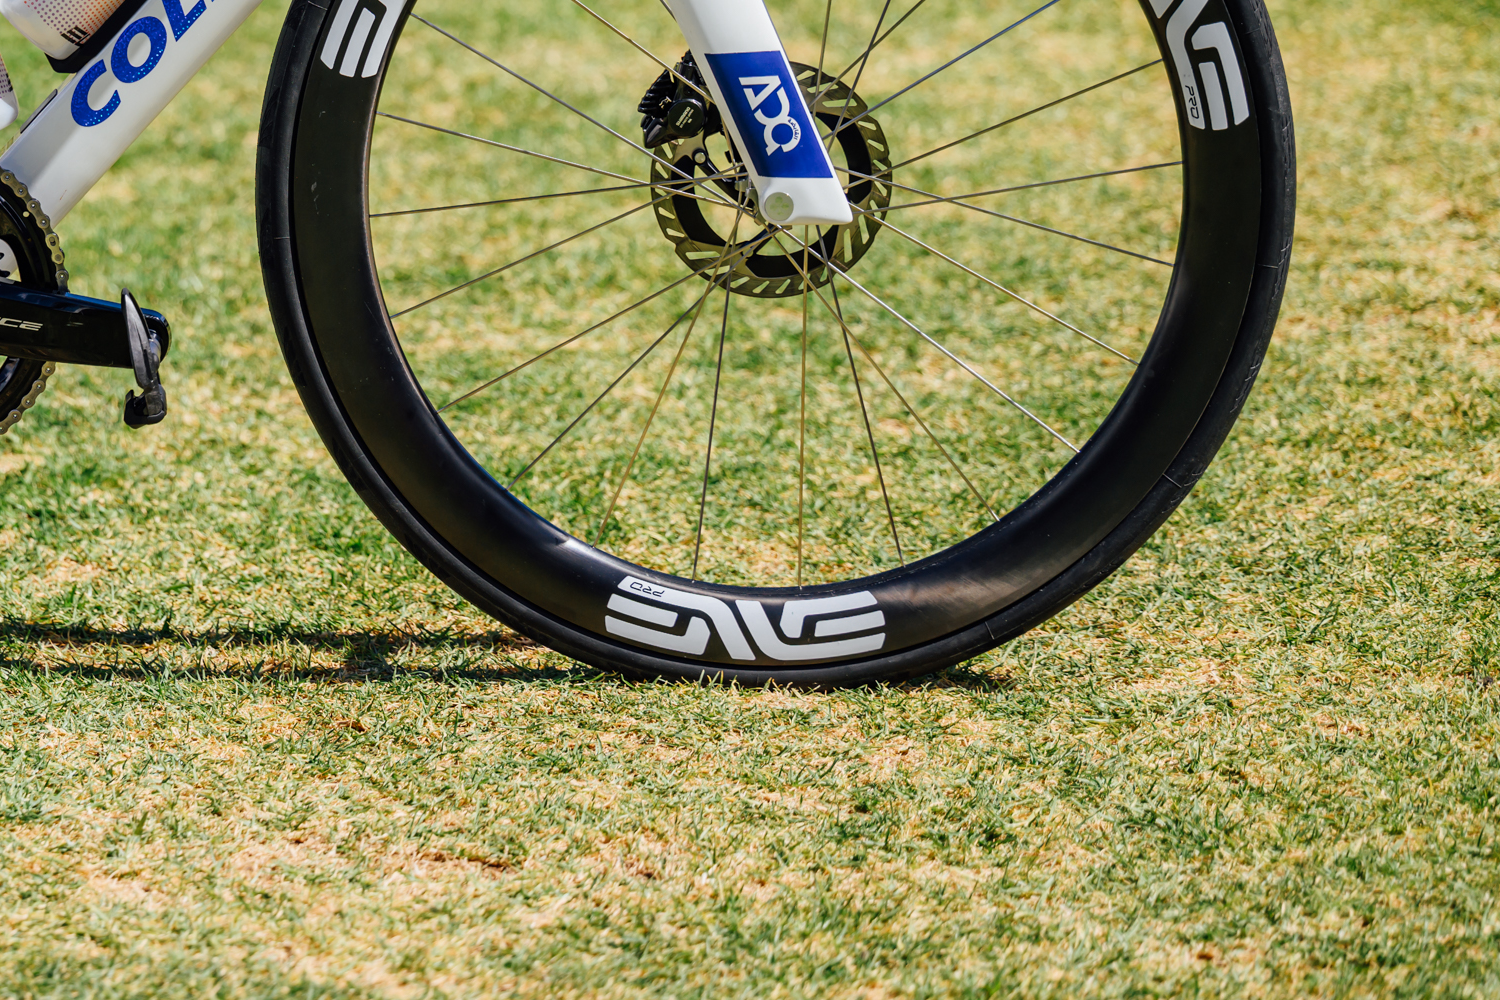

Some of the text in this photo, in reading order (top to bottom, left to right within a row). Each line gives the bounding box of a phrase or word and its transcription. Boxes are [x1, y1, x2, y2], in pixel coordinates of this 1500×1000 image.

[738, 75, 801, 157] ADQ
[1185, 85, 1201, 120] PRO
[604, 575, 886, 661] ENVE
[629, 581, 665, 598] PRO
